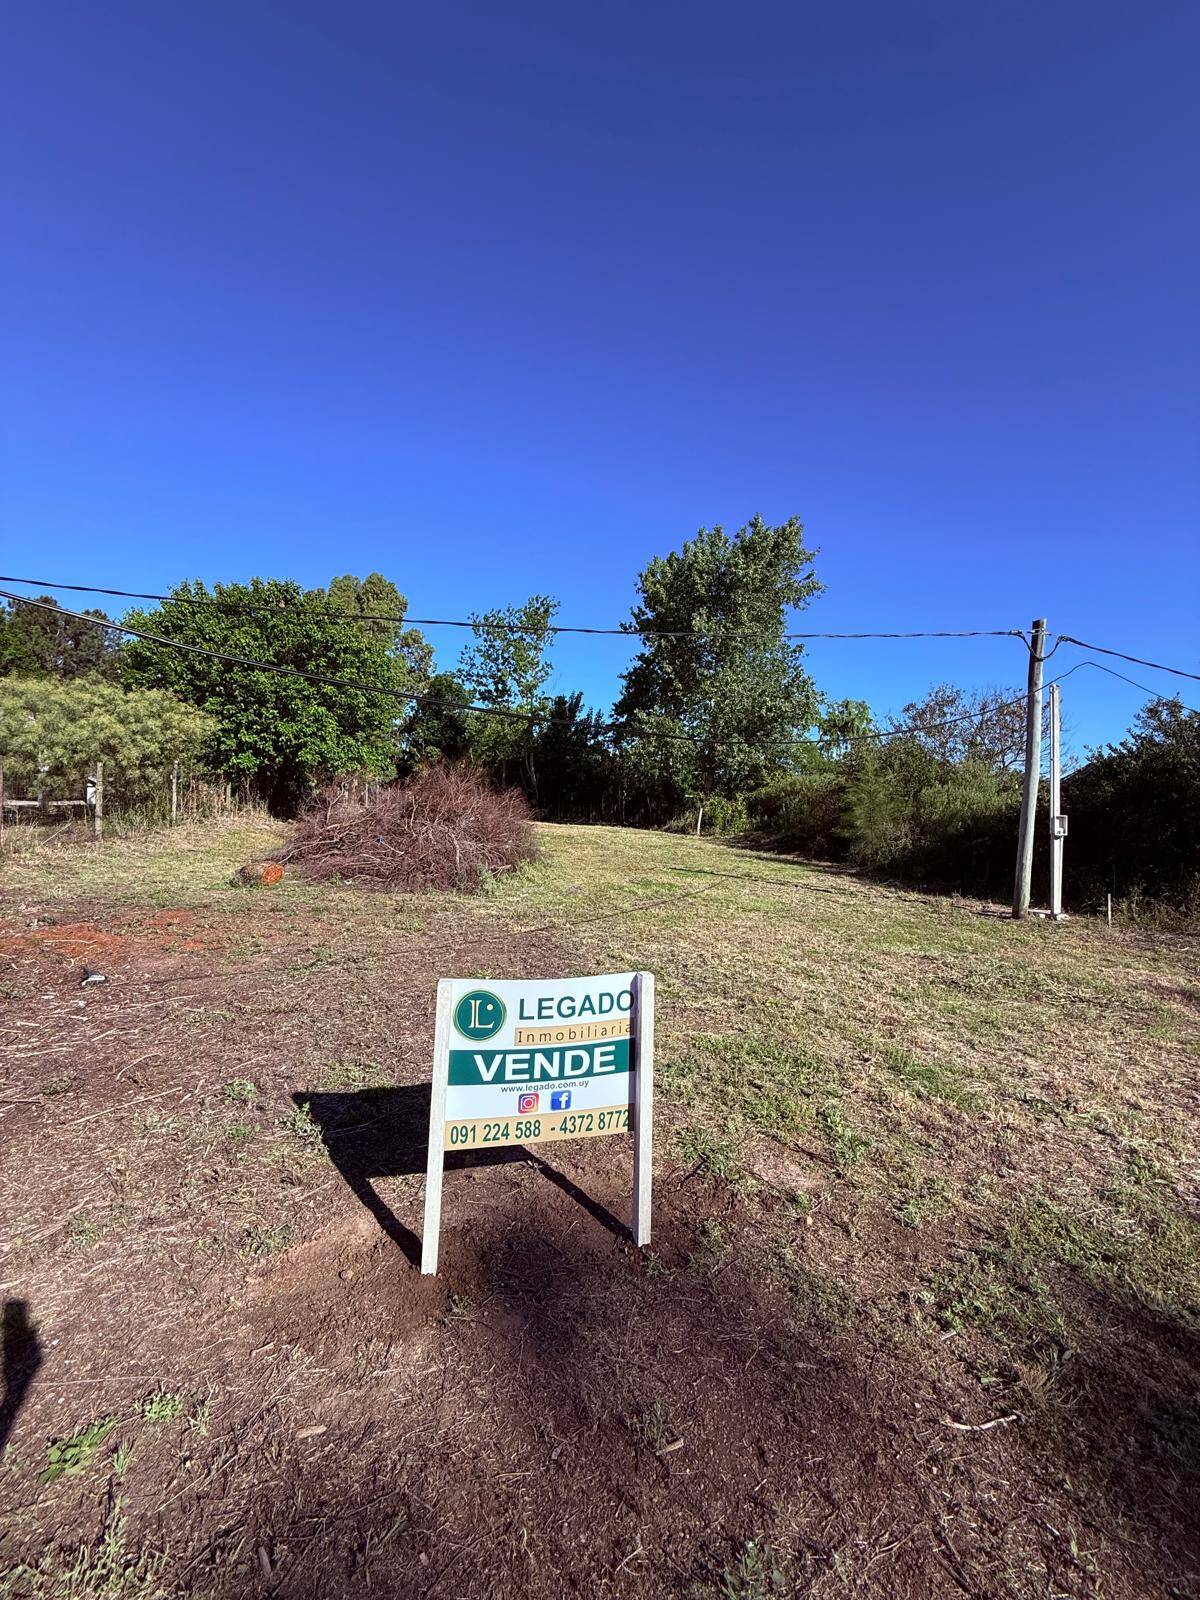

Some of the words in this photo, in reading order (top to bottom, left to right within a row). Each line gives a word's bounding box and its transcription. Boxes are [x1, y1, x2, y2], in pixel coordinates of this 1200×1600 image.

[519, 990, 634, 1020] LEGADO
[518, 1023, 632, 1043] Inmobiliaria
[474, 1046, 616, 1081] VENDE
[501, 1080, 589, 1093] www.legado.com.uy
[450, 1125, 476, 1144] 091
[482, 1122, 510, 1142] 224
[515, 1120, 541, 1138] 588
[559, 1114, 593, 1134] 4372
[598, 1109, 629, 1130] 8772
